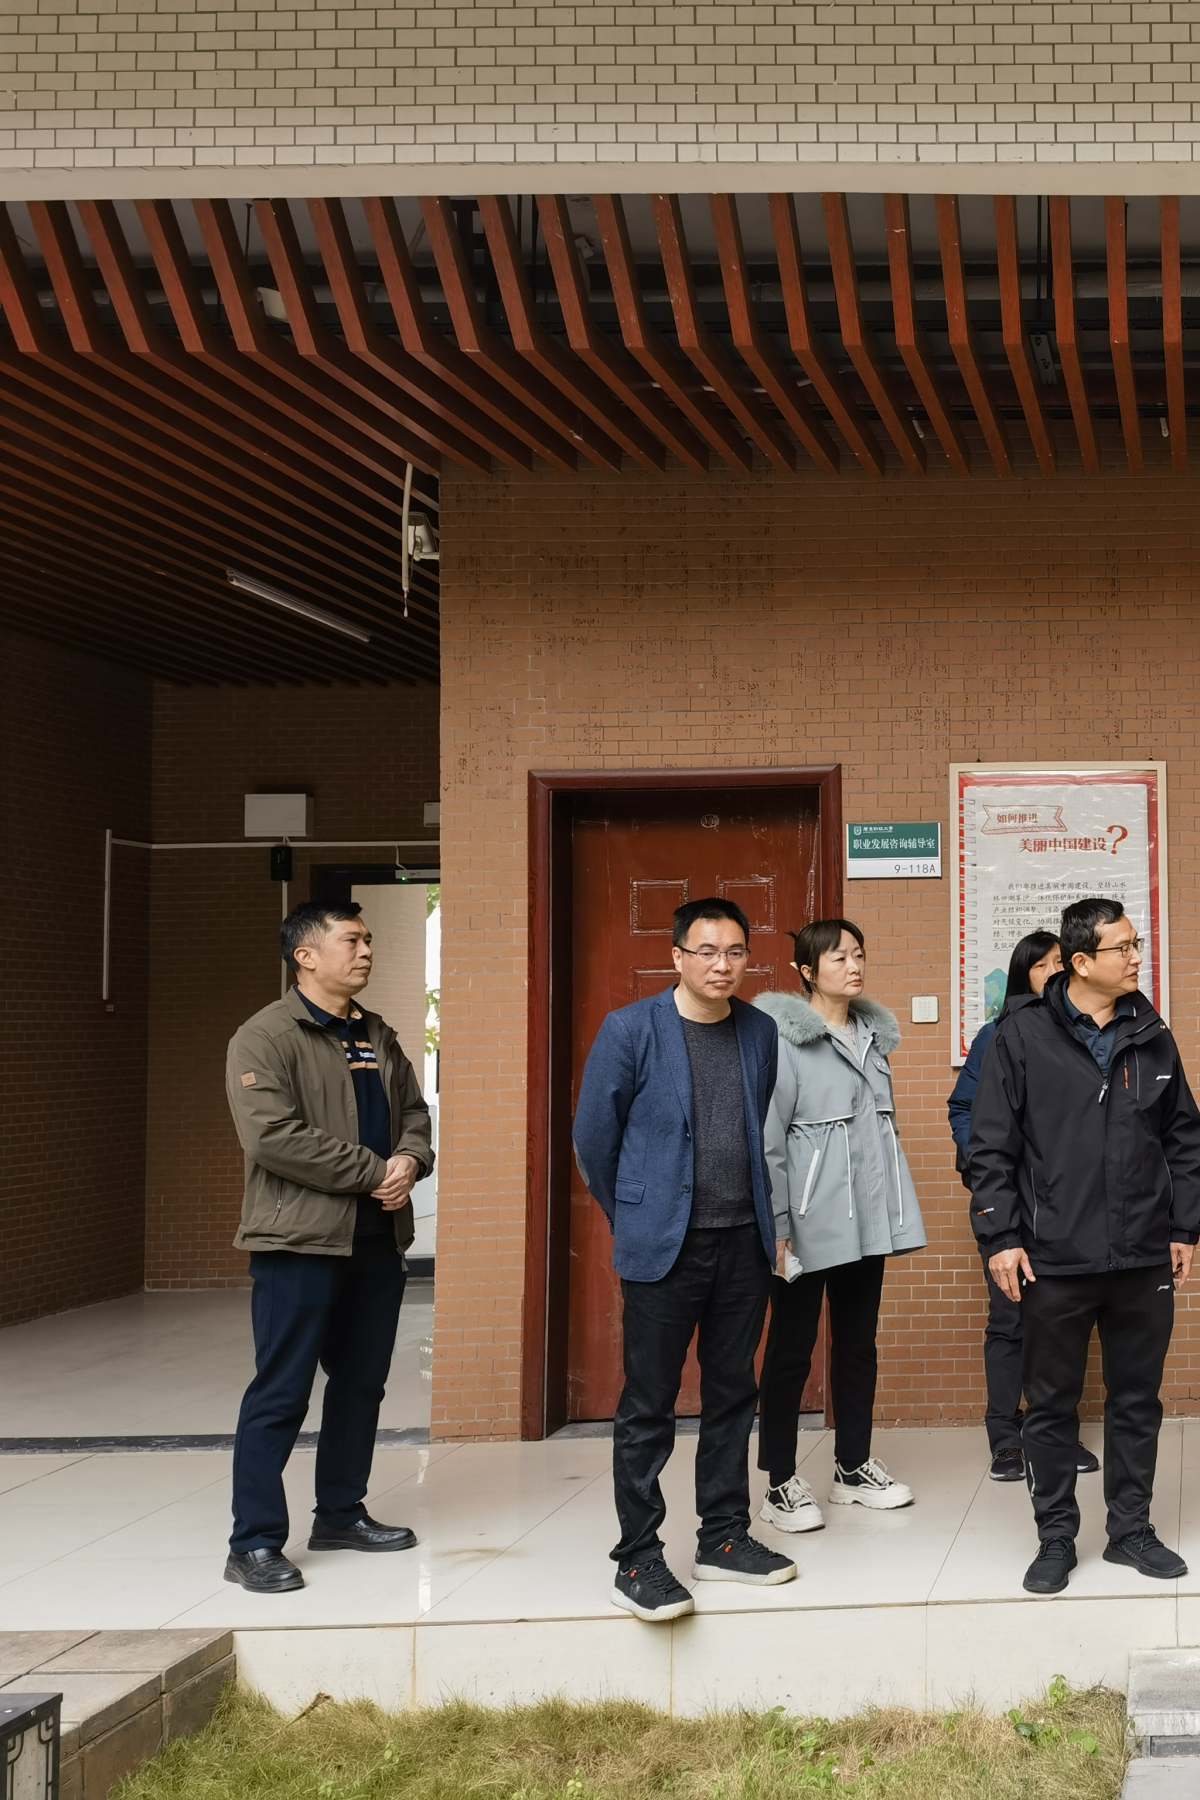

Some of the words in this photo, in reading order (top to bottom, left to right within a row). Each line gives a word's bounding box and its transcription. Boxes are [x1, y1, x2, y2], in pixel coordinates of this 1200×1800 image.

[996, 812, 1038, 824] 如何推进
[853, 837, 936, 850] 职业发展咨询辅导室
[894, 864, 936, 874] 9-118A
